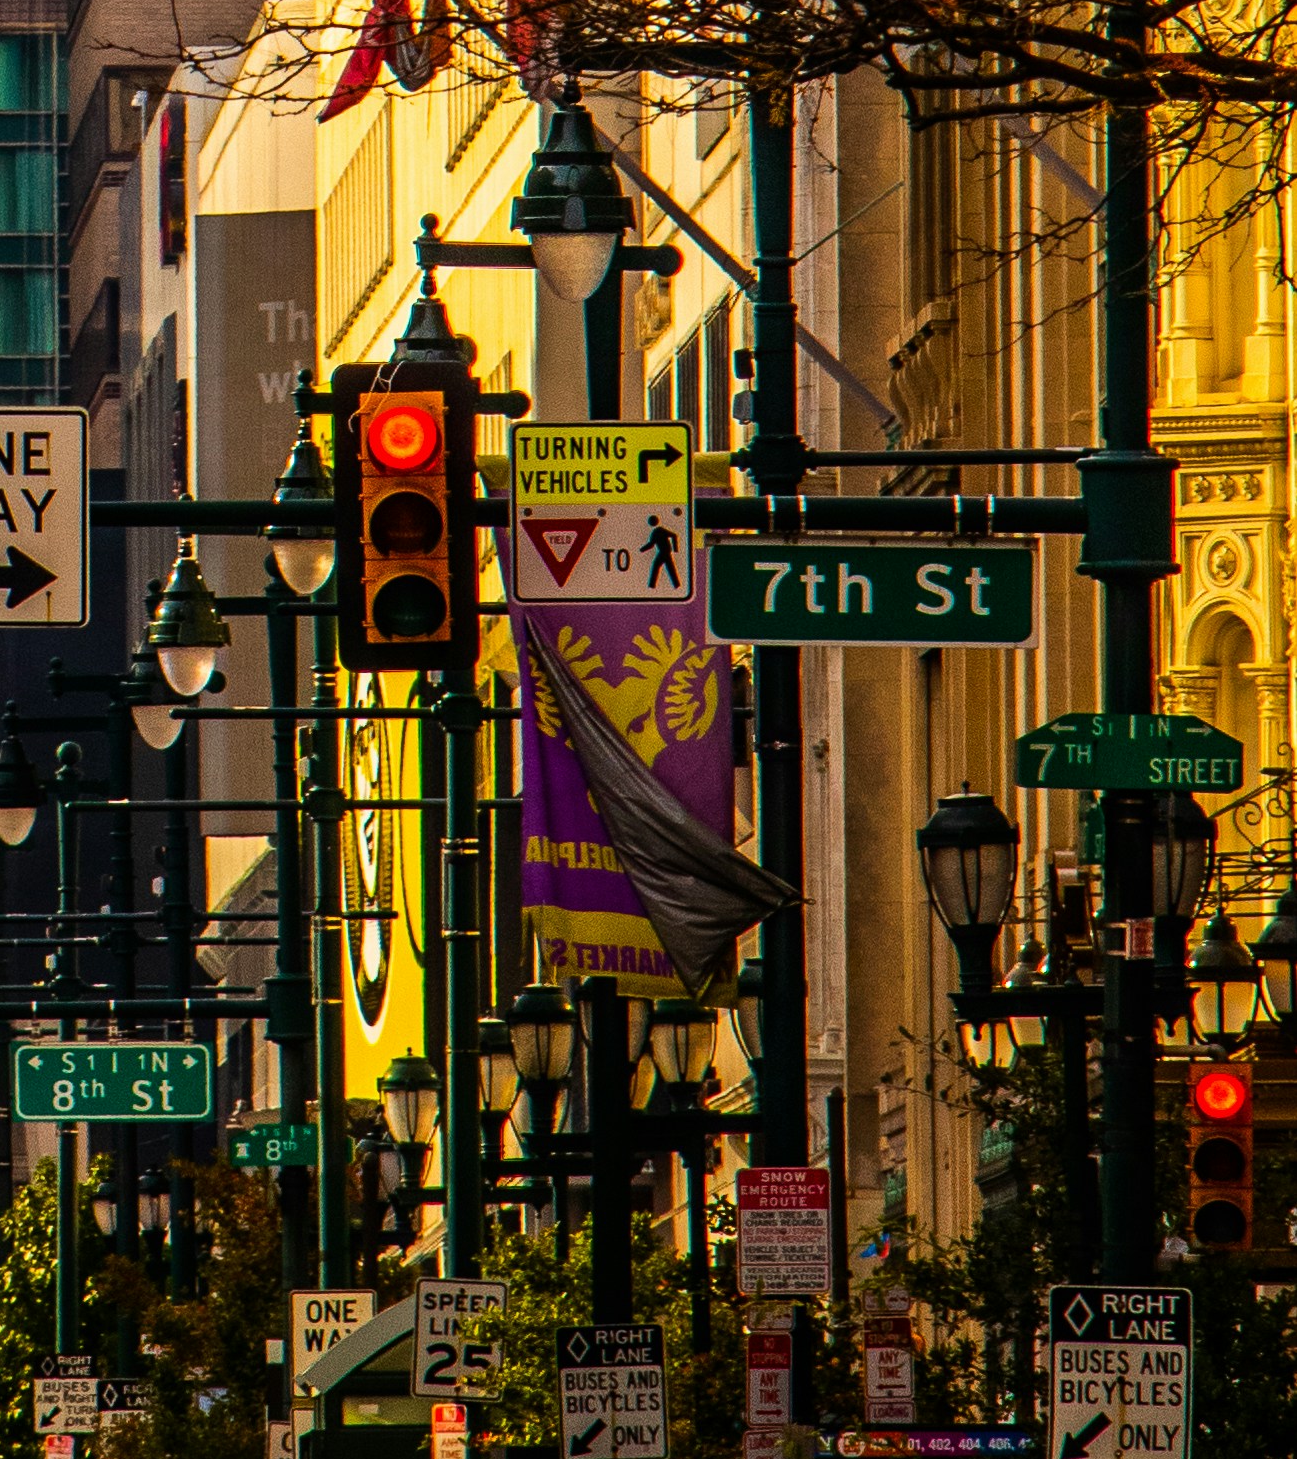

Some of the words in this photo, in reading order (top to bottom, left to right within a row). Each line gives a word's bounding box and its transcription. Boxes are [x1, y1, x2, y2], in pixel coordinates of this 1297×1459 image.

[519, 436, 627, 460] TURNING
[520, 470, 628, 494] VEHICLES
[549, 535, 571, 545] YIELD
[602, 548, 631, 571] TO
[754, 560, 873, 614] 7th
[915, 562, 991, 615] St
[1092, 716, 1104, 736] S
[1158, 717, 1171, 737] N
[1149, 757, 1240, 784] STREET
[62, 1051, 76, 1074] S
[151, 1051, 169, 1073] N
[51, 1078, 106, 1111] 8th
[132, 1078, 174, 1112] St
[265, 1138, 298, 1162] 8th
[760, 1171, 808, 1182] SNOW
[740, 1184, 826, 1195] EMERGENCY
[758, 1196, 808, 1207] ROUTE
[306, 1299, 359, 1323] ONE
[1101, 1293, 1181, 1315] RIGHT
[304, 1328, 352, 1352] WA
[595, 1328, 655, 1344] RIGHT
[1109, 1319, 1177, 1341] LANE
[763, 1338, 775, 1349] NO
[57, 1355, 93, 1365] RIGHT
[424, 1342, 492, 1386] 25
[601, 1347, 654, 1364] LANE
[751, 1353, 788, 1365] STOPPING
[878, 1351, 899, 1363] ANY
[1060, 1349, 1130, 1374] BUSES
[1140, 1351, 1183, 1375] AND
[59, 1366, 92, 1376] LANE
[565, 1371, 619, 1391] BUSES
[626, 1370, 659, 1389] AND
[759, 1373, 778, 1386] ANY
[877, 1367, 902, 1379] TIME
[42, 1382, 91, 1393] BUSES
[758, 1389, 780, 1404] TIME
[1059, 1380, 1182, 1406] BICYCLES
[36, 1395, 60, 1403] AND
[566, 1393, 660, 1414] BICYCLES
[64, 1416, 98, 1426] ONLY
[873, 1406, 909, 1418] LOADING
[613, 1425, 660, 1445] ONLY
[1118, 1423, 1181, 1451] ONLY
[440, 1448, 462, 1459] TIME
